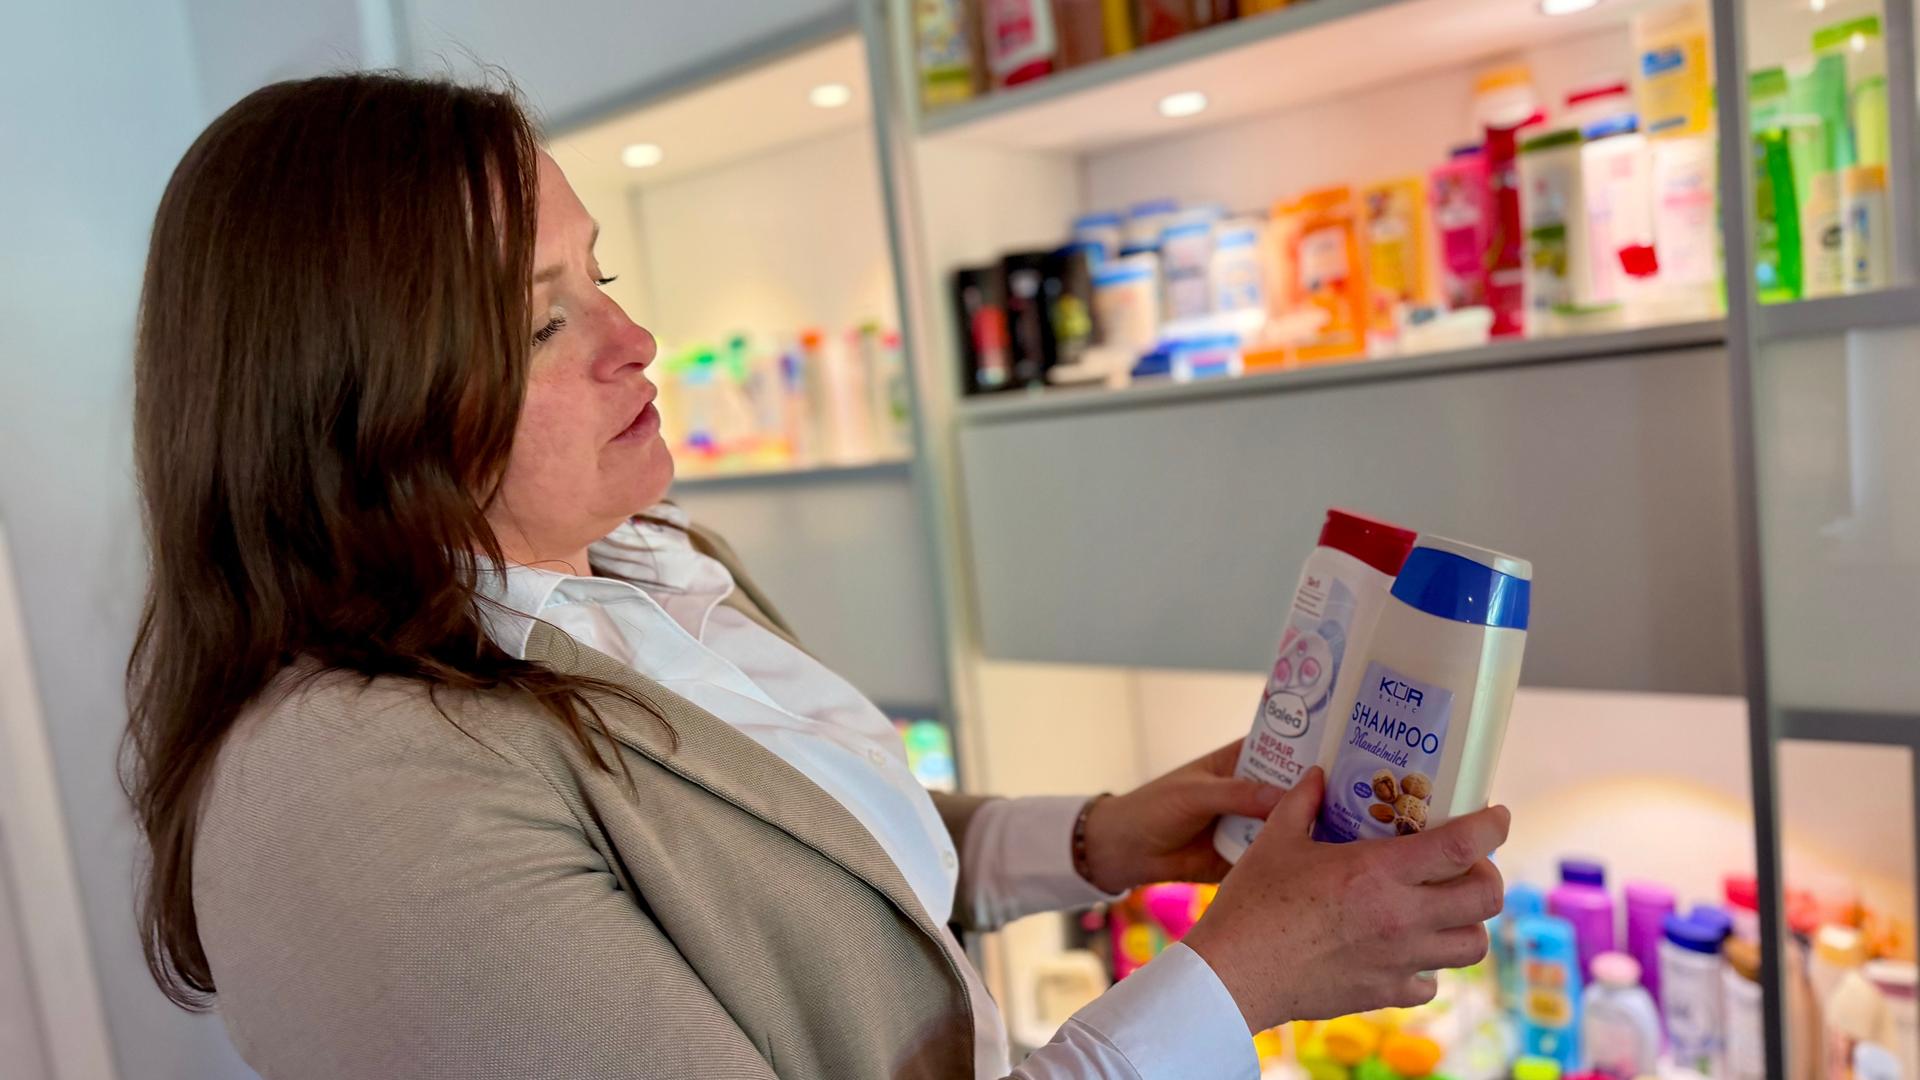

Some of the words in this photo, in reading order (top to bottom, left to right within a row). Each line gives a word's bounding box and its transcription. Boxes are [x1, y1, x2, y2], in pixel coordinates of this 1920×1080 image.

[1267, 700, 1304, 729] Balea
[1380, 694, 1418, 714] BASIC
[1352, 702, 1439, 754] SHAMPOO
[1254, 742, 1304, 776] PROTECT
[1259, 732, 1294, 758] REPAIR
[1349, 726, 1409, 768] Mandelmilch
